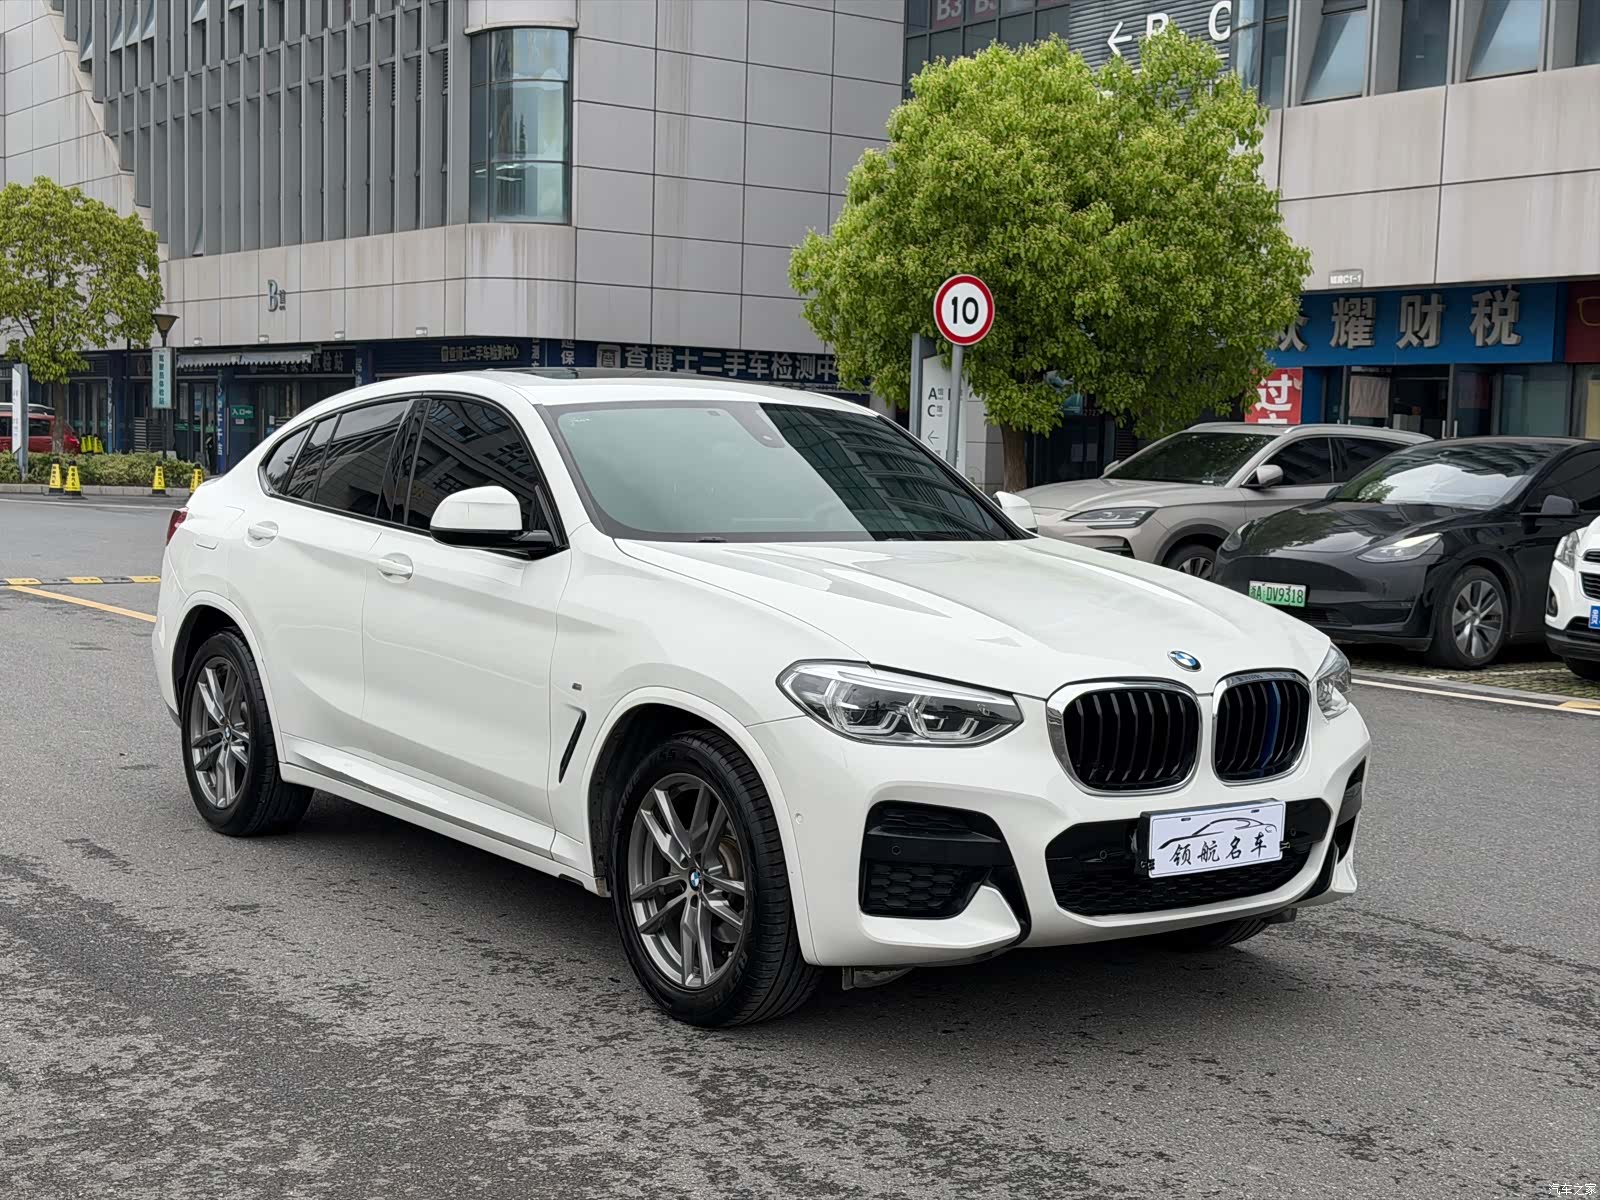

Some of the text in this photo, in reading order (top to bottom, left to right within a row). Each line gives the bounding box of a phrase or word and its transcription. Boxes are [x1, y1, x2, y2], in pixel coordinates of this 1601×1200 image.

[1208, 1, 1231, 41] C
[951, 296, 979, 325] 10
[928, 387, 937, 400] A
[231, 407, 246, 416] 入口
[927, 404, 936, 417] C
[1169, 831, 1268, 867] 领航名车
